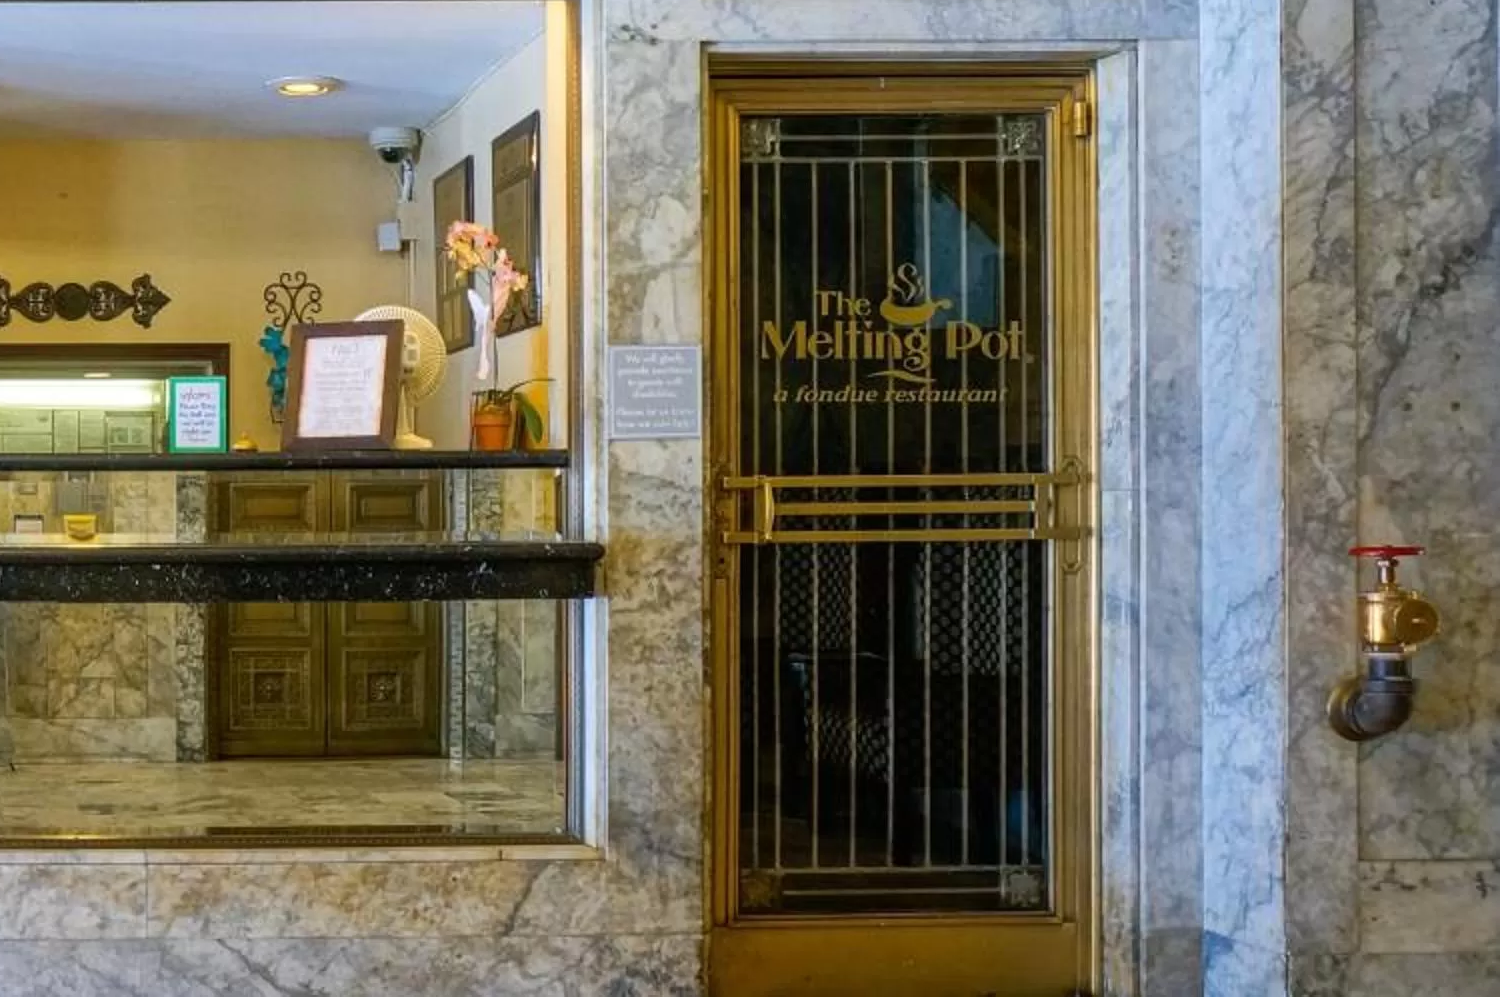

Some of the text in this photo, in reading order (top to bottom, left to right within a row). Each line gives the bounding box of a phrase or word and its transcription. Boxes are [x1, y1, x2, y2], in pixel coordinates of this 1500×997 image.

[814, 289, 873, 317] The
[760, 319, 932, 373] Melting
[772, 384, 1009, 404] a fondue restaurant
